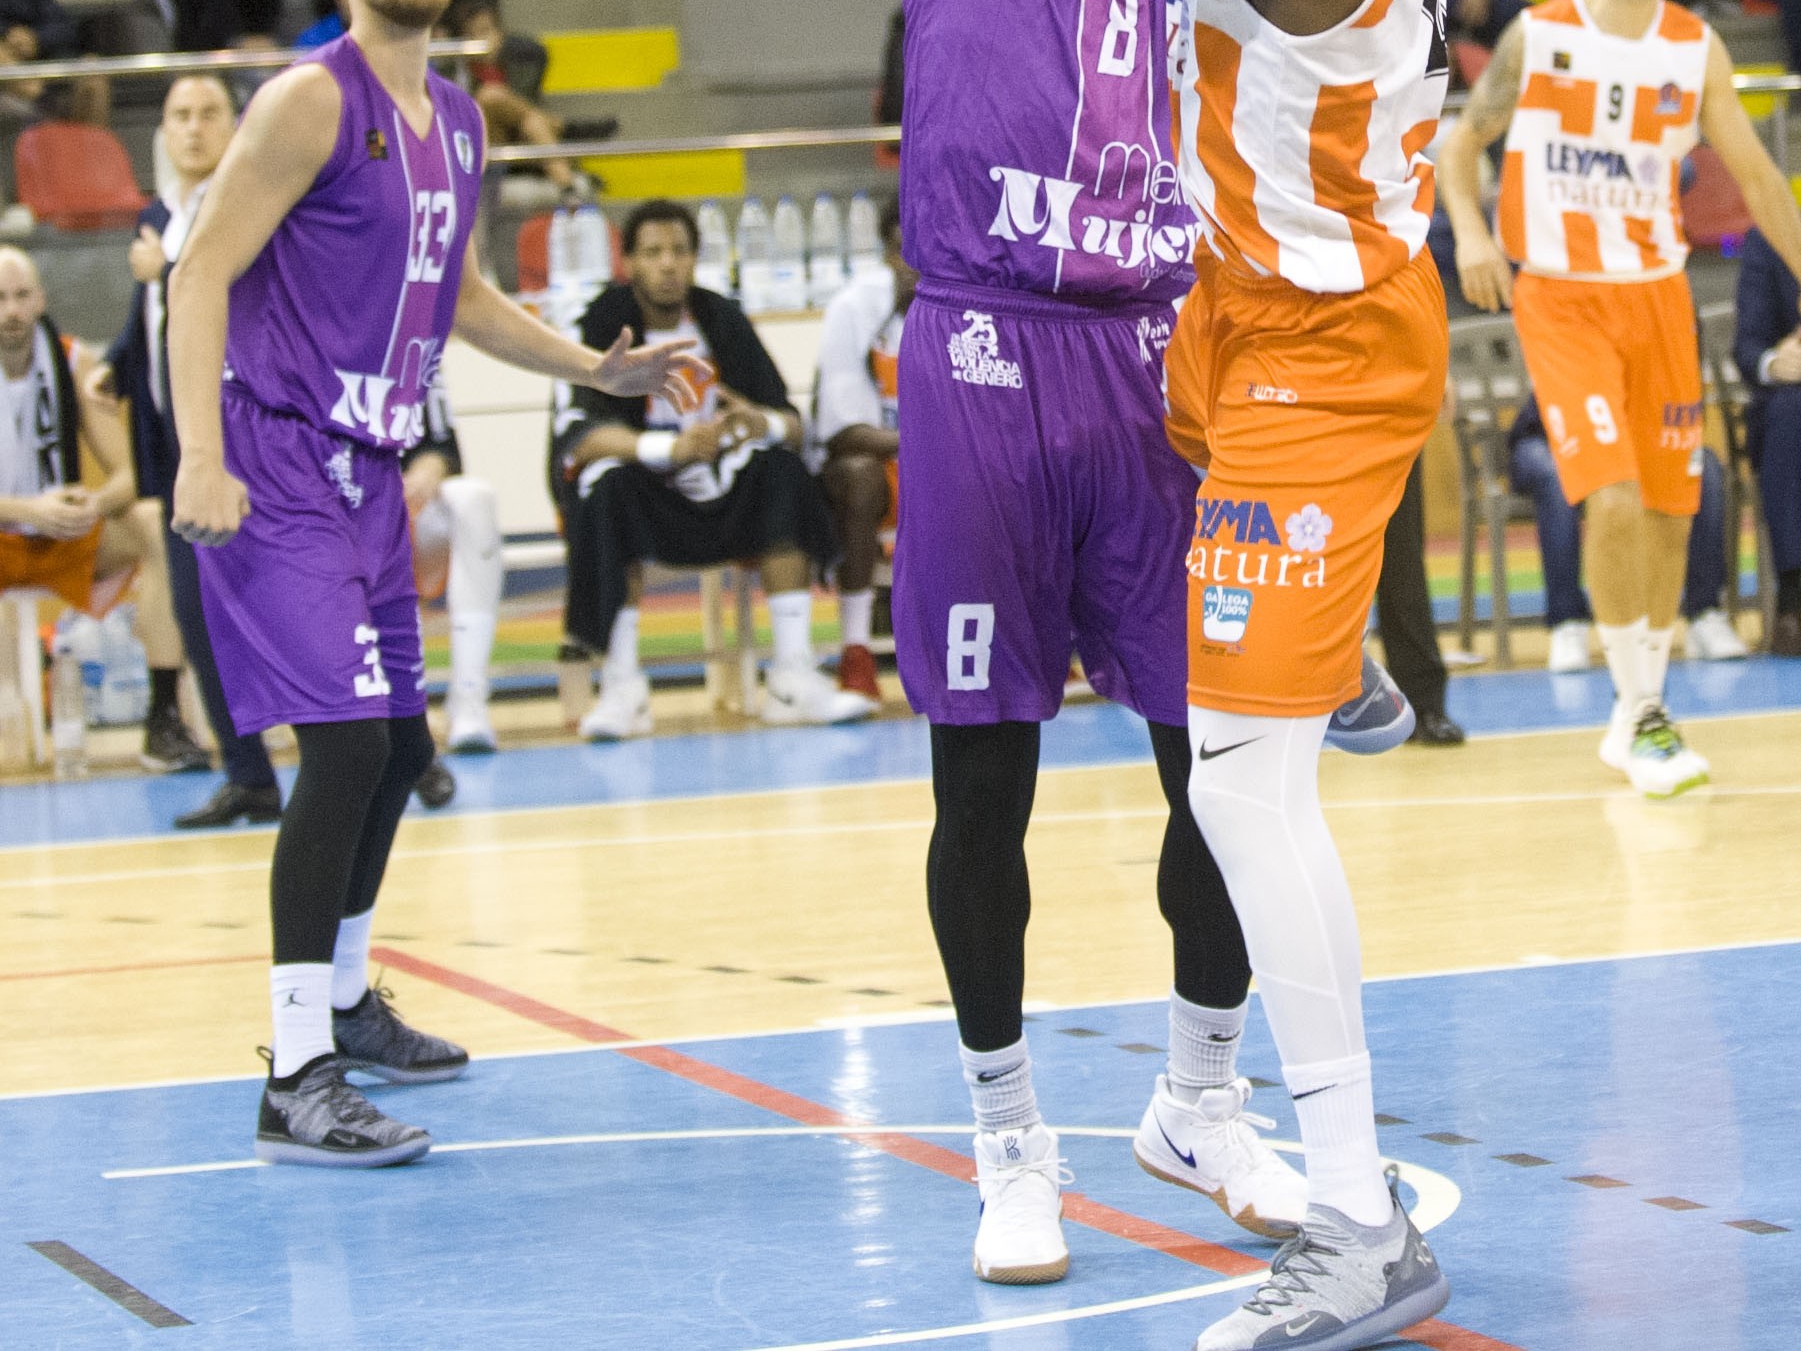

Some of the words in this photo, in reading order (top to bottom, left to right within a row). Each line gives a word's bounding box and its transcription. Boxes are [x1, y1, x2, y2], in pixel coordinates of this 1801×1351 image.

[1608, 82, 1624, 121] 9
[1545, 142, 1635, 182] LEYMA
[404, 190, 456, 284] 33
[949, 350, 1021, 377] VIOLENCIA
[962, 368, 1024, 390] GENERO
[1585, 393, 1619, 445] 9
[1196, 499, 1281, 546] YMA
[946, 602, 996, 691] 8
